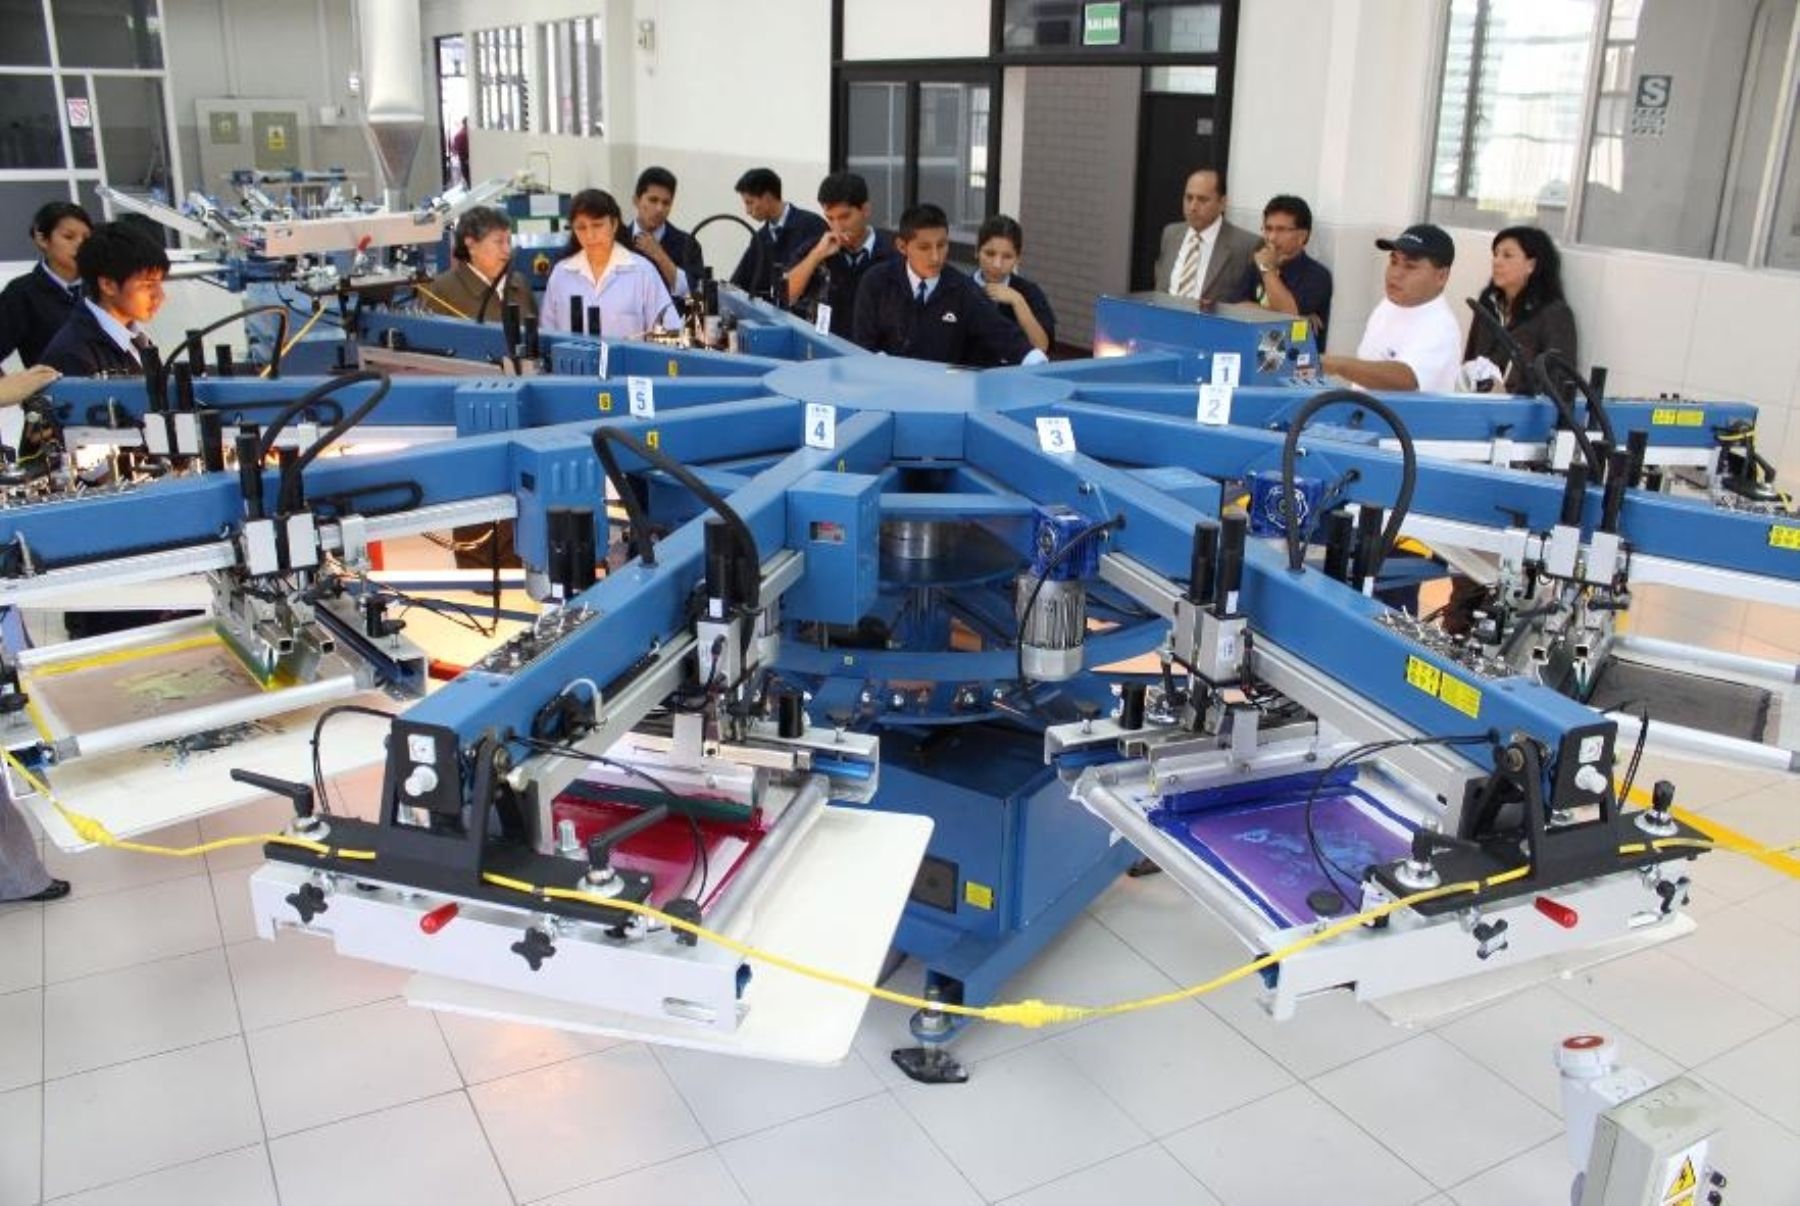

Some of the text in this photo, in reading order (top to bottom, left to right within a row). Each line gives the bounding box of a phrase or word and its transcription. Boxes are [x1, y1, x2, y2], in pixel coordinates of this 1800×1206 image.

[1642, 78, 1667, 107] S
[636, 391, 646, 410] 5
[1208, 400, 1220, 418] 2
[814, 421, 826, 441] 4
[1050, 430, 1064, 447] 3
